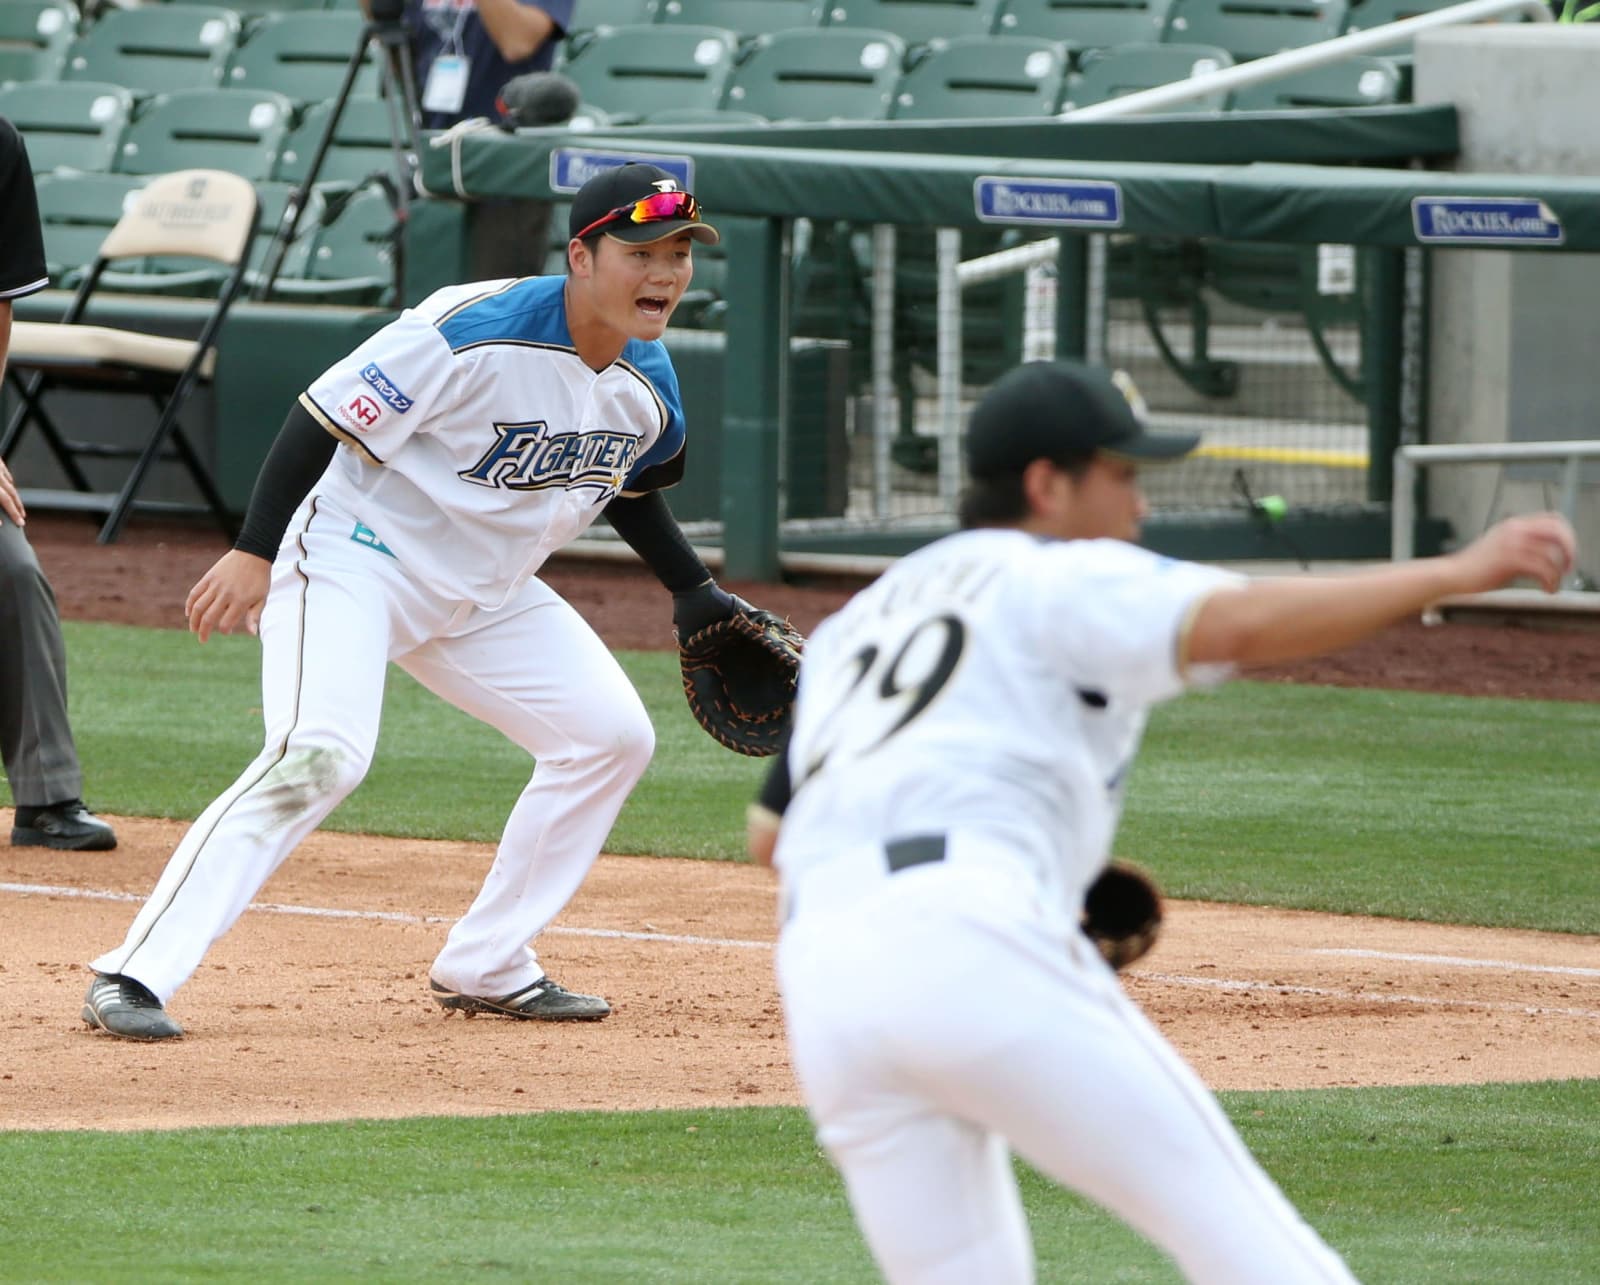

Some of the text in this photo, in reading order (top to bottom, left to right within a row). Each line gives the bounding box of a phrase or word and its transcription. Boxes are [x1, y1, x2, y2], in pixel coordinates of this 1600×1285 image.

[373, 376, 409, 410] ホクレン
[349, 398, 377, 426] NH
